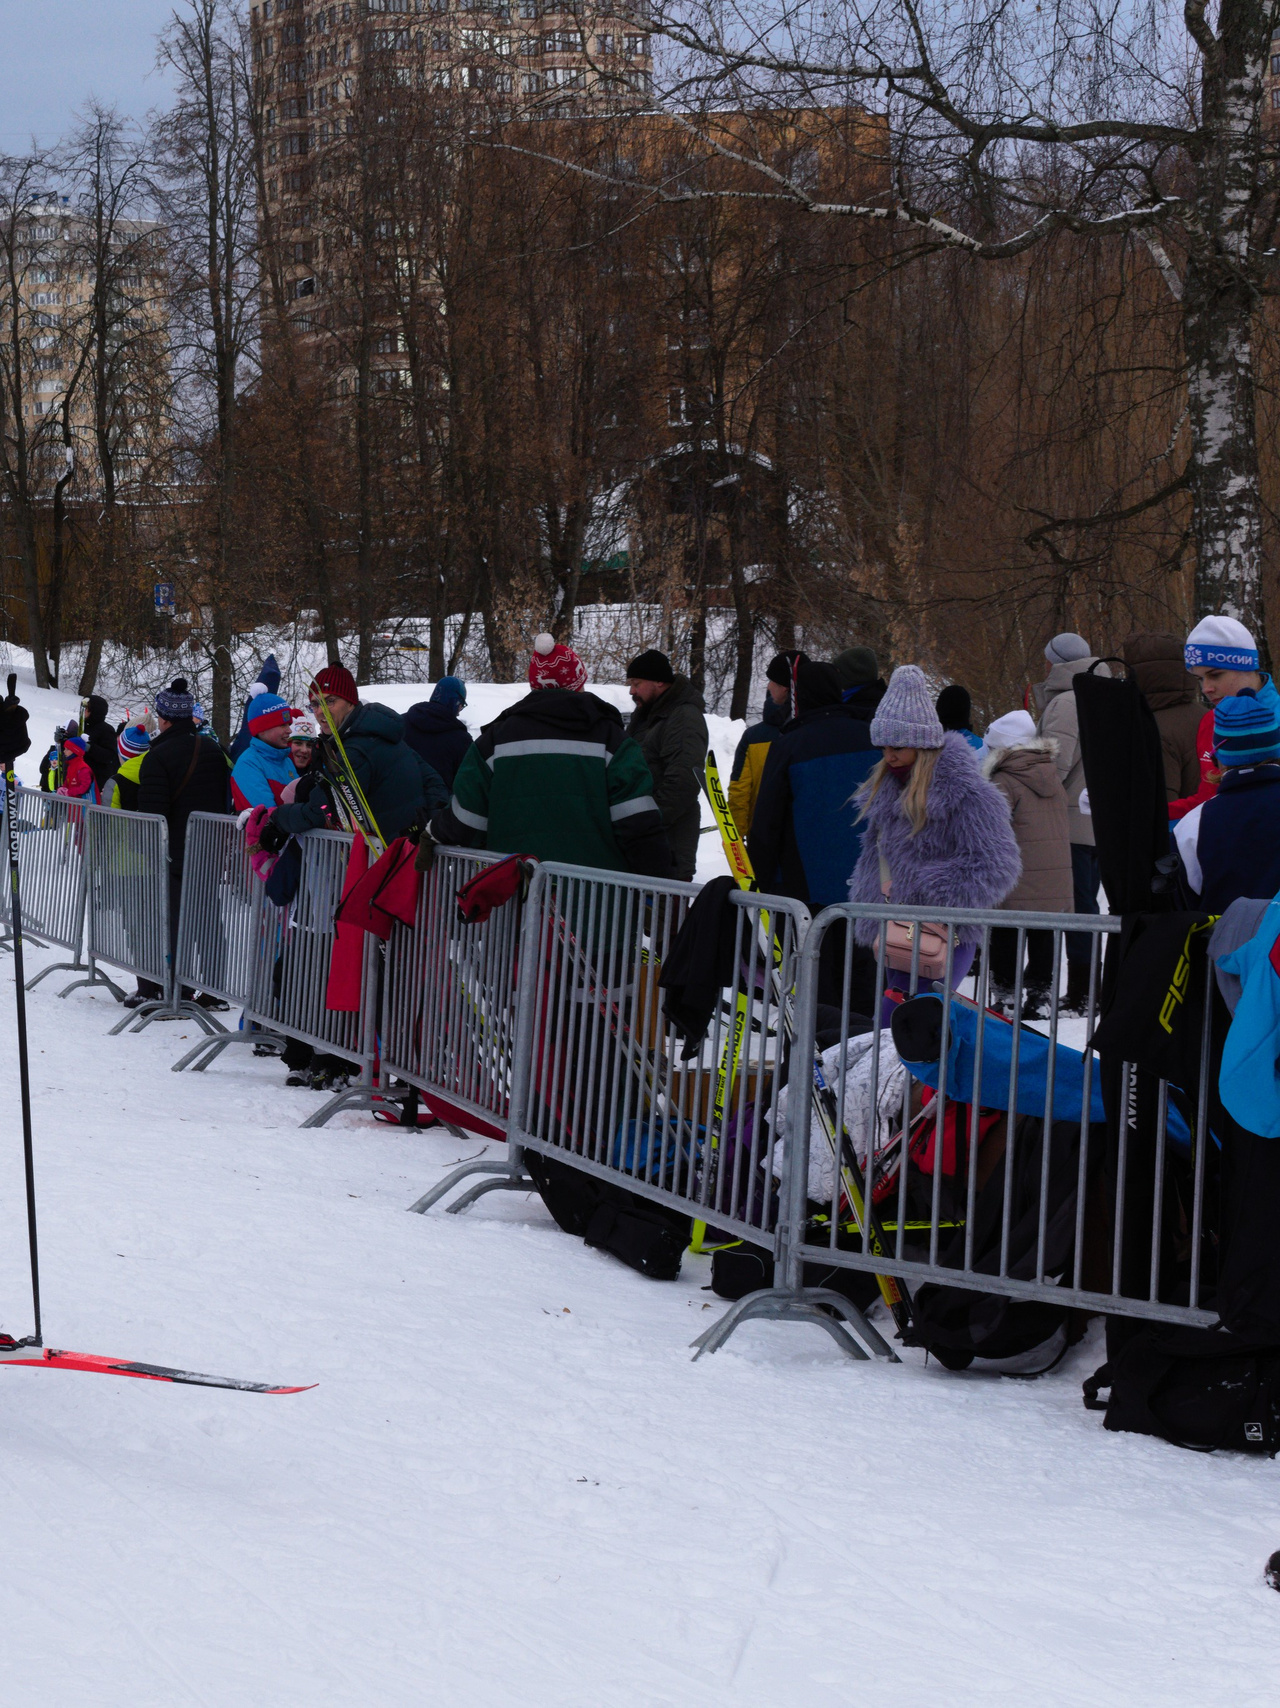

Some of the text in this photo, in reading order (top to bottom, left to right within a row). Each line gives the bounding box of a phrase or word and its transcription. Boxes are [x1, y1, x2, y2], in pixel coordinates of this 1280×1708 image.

[1207, 652, 1253, 665] РОССИИ
[341, 784, 363, 821] NORDWAY
[8, 788, 19, 861] NORDWAY
